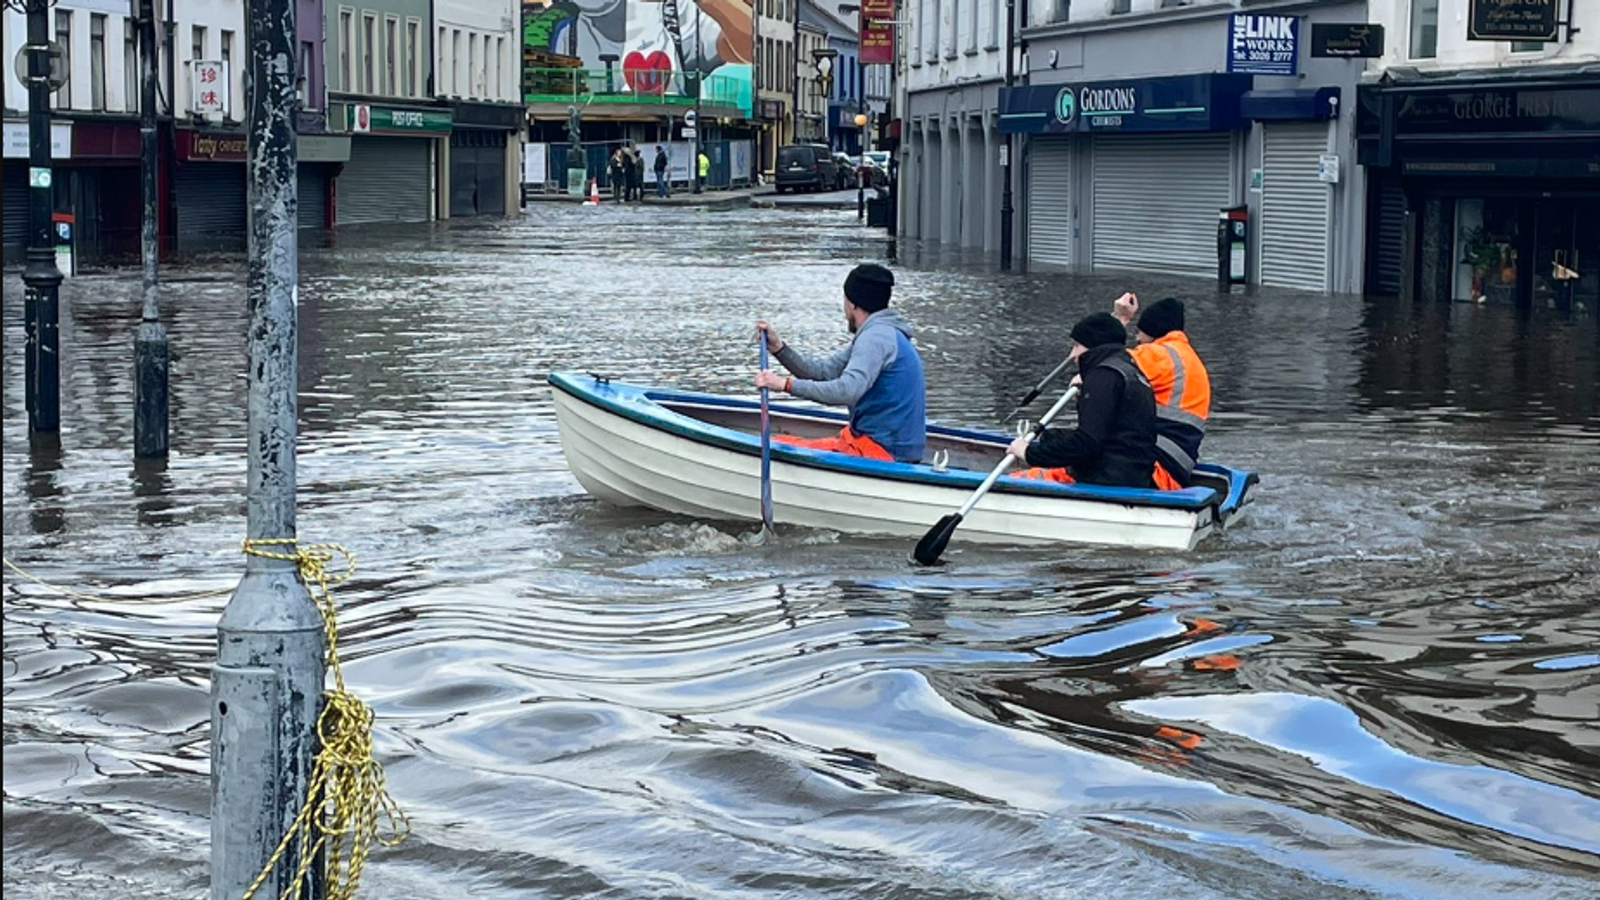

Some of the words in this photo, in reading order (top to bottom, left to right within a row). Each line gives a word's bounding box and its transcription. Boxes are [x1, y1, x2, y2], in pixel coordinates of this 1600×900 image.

[1233, 15, 1247, 49] THE
[1247, 16, 1294, 39] LINK
[1247, 39, 1293, 51] WORKS
[201, 67, 217, 105] 珍味
[1081, 87, 1135, 111] GORDONS
[1454, 97, 1511, 119] GEORGE
[392, 111, 405, 126] POST
